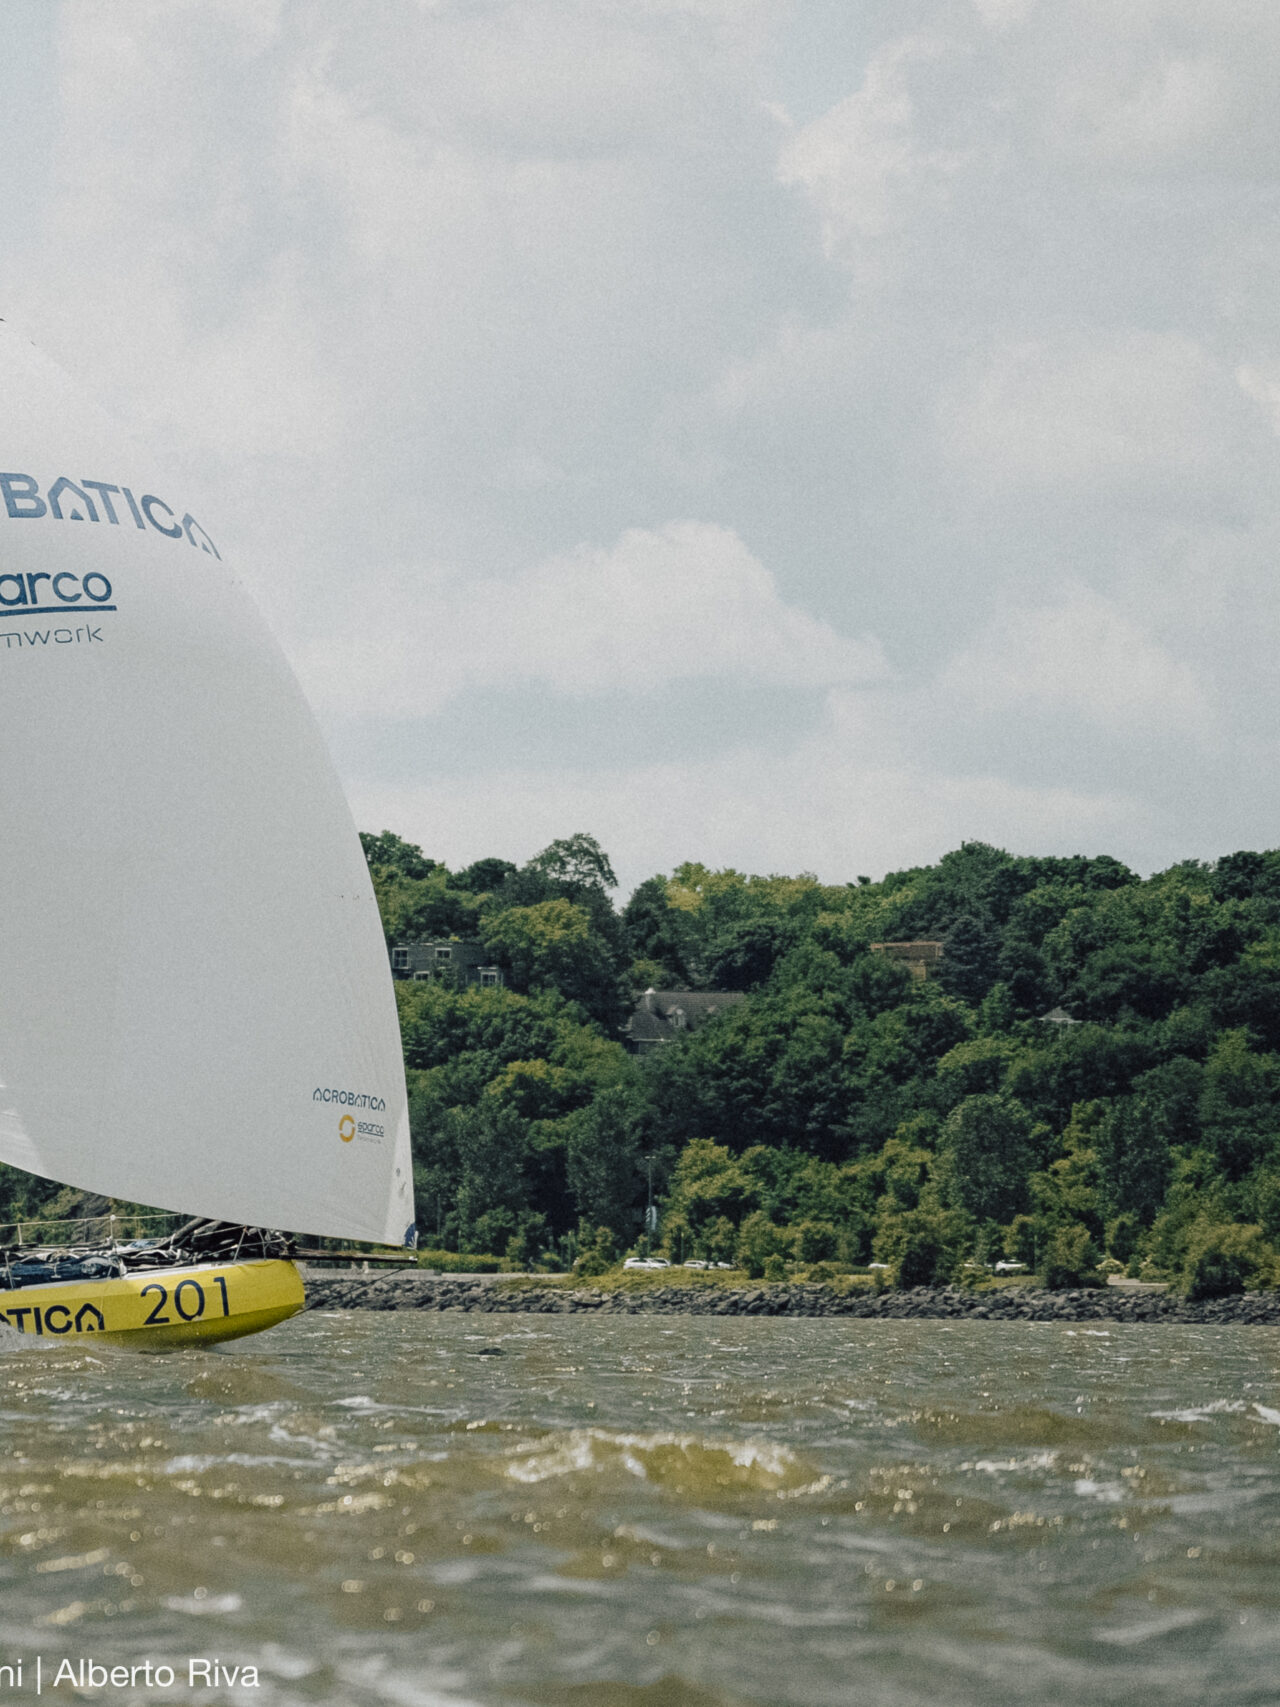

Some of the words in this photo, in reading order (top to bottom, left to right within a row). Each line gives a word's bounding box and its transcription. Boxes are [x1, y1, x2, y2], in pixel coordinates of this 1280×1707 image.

[313, 1088, 386, 1111] ACROBATICA
[357, 1121, 384, 1136] sparco
[140, 1276, 230, 1326] 201
